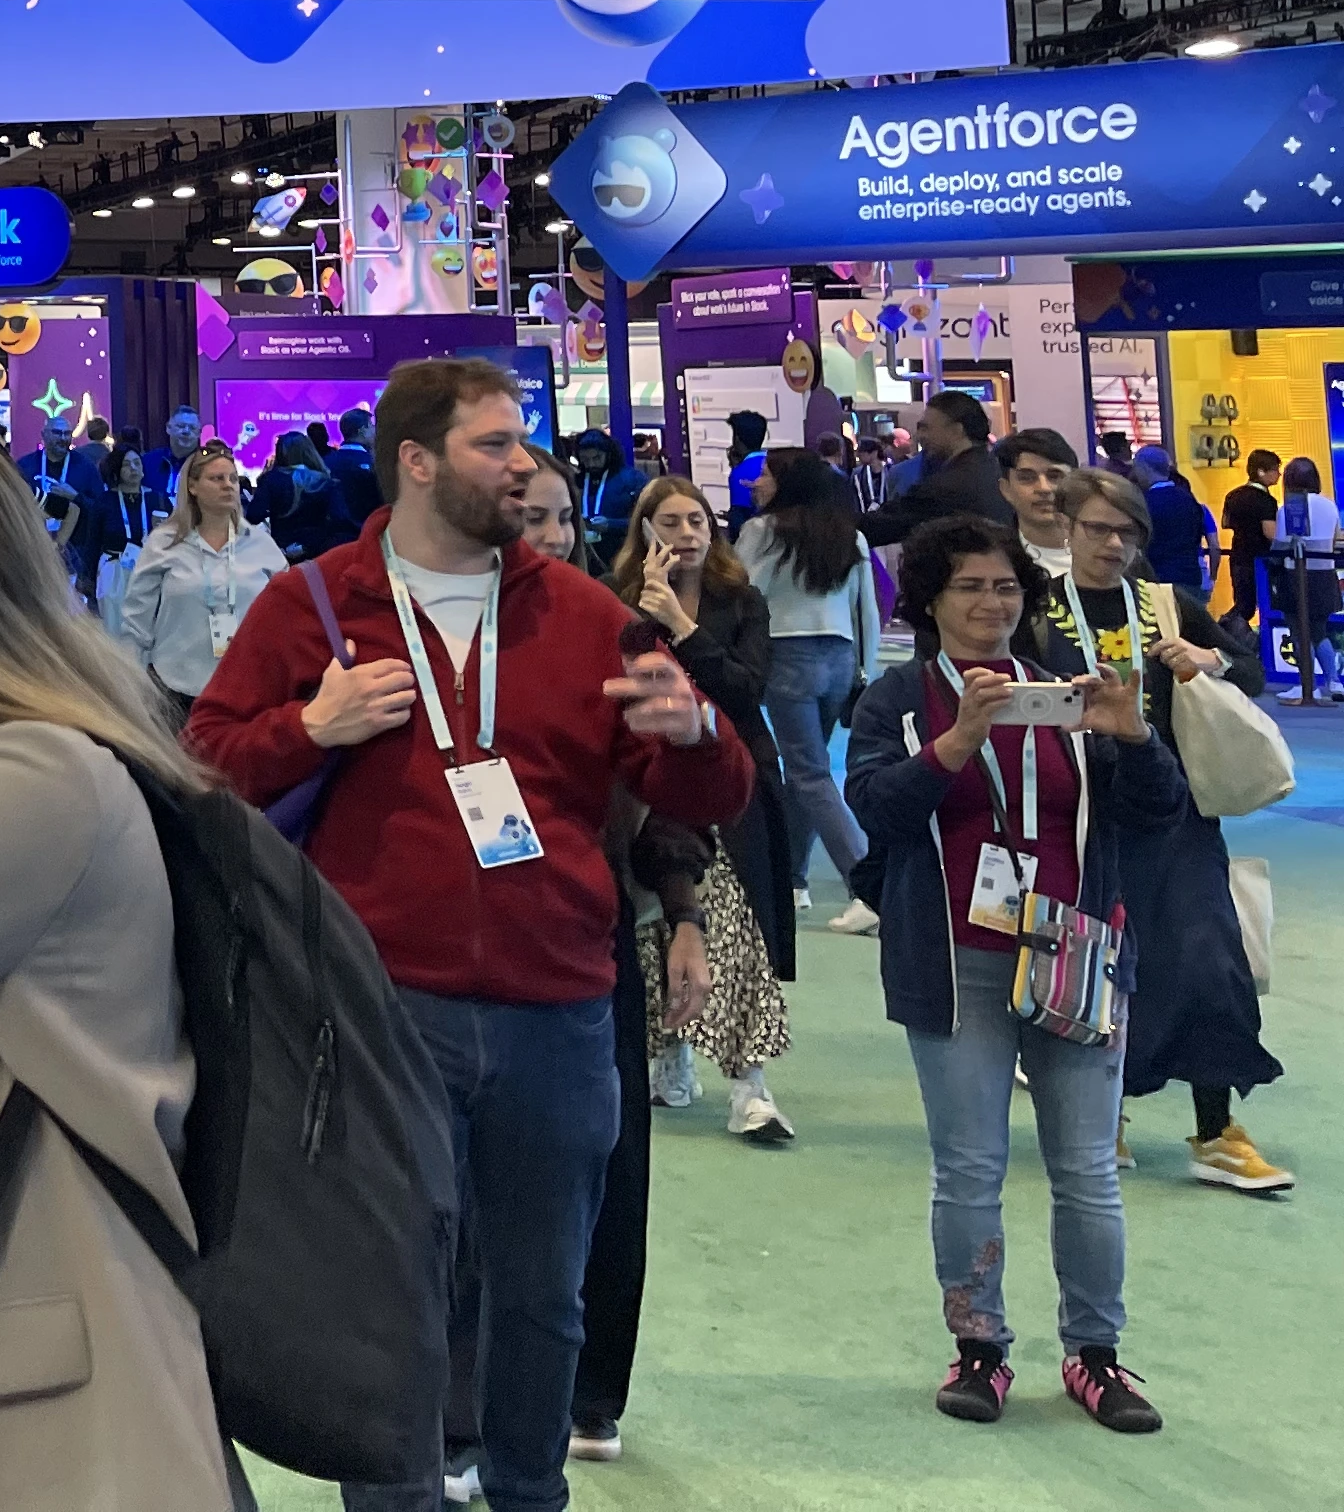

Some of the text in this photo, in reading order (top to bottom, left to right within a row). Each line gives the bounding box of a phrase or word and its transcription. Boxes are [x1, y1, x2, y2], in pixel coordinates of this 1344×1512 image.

[839, 102, 1138, 168] Agentforce
[858, 162, 1123, 197] Build, deploy, and scale
[859, 187, 1132, 221] enterprise-ready agents.
[1043, 339, 1113, 353] trused
